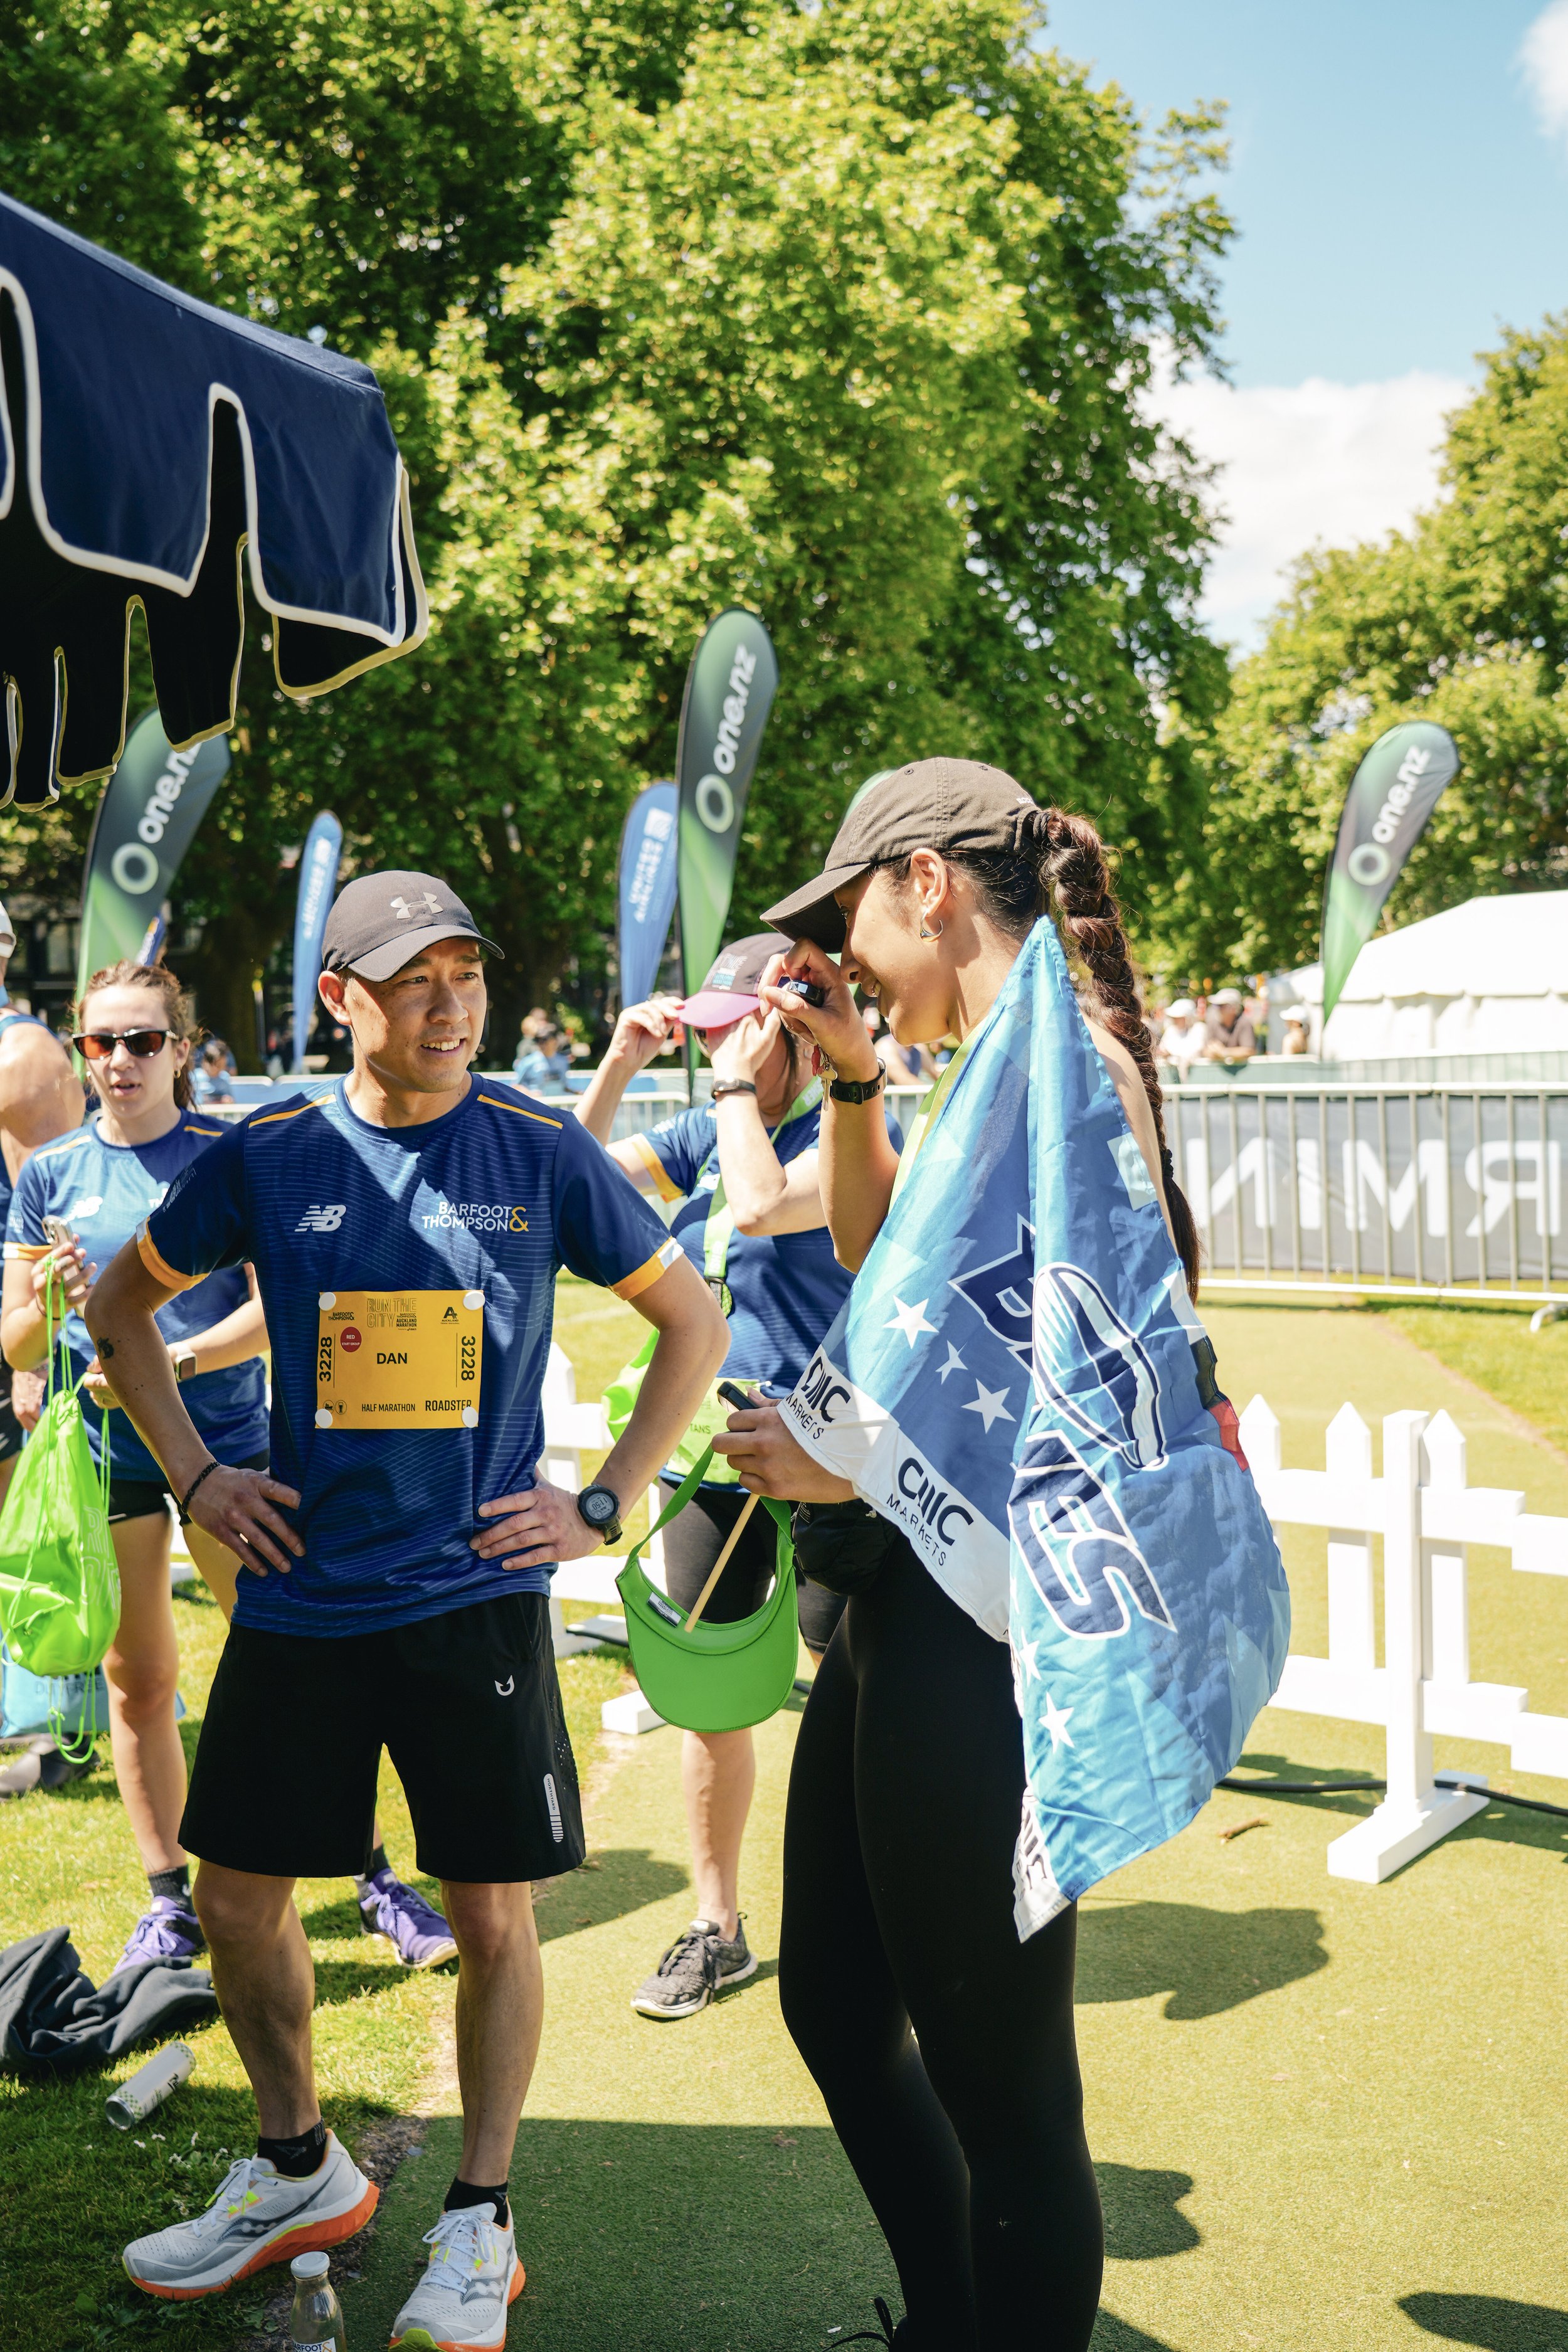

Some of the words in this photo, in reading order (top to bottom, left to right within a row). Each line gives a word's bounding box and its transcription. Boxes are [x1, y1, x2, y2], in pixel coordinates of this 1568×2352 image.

[713, 642, 756, 775] one.nz
[1372, 744, 1431, 844] one.nz
[422, 1214, 510, 1232] THOMPSON
[438, 1201, 512, 1219] BARFOOT
[509, 1206, 529, 1232] &
[367, 1298, 391, 1312] RUN
[393, 1298, 416, 1312] THE
[367, 1313, 395, 1328] CITY
[319, 1337, 332, 1382] 3228
[376, 1353, 408, 1364] DAN
[461, 1336, 475, 1380] 3228
[361, 1404, 377, 1412] HALF
[378, 1404, 416, 1412] MARATHON
[425, 1400, 472, 1411] ROADSTER
[886, 1493, 946, 1566] MARKETS
[547, 1778, 555, 1811] NORTHYARD
